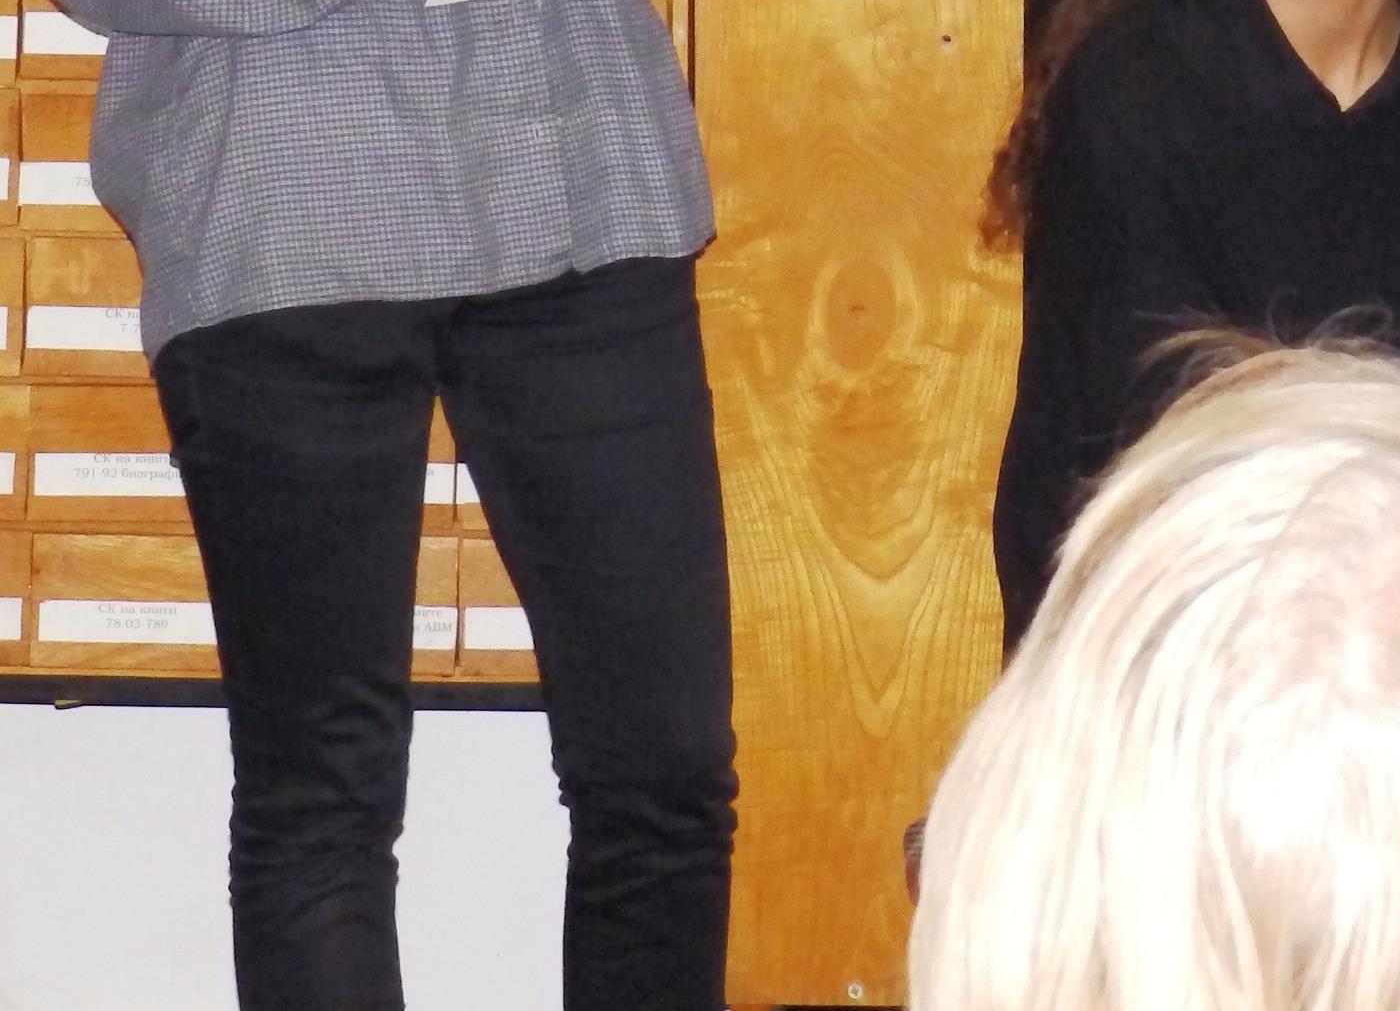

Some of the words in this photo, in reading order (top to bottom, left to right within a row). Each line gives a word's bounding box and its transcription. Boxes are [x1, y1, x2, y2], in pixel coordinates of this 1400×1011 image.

[105, 307, 122, 318] СК
[93, 454, 110, 464] СК
[98, 603, 115, 614] СК
[120, 605, 137, 615] на
[140, 606, 177, 616] книги
